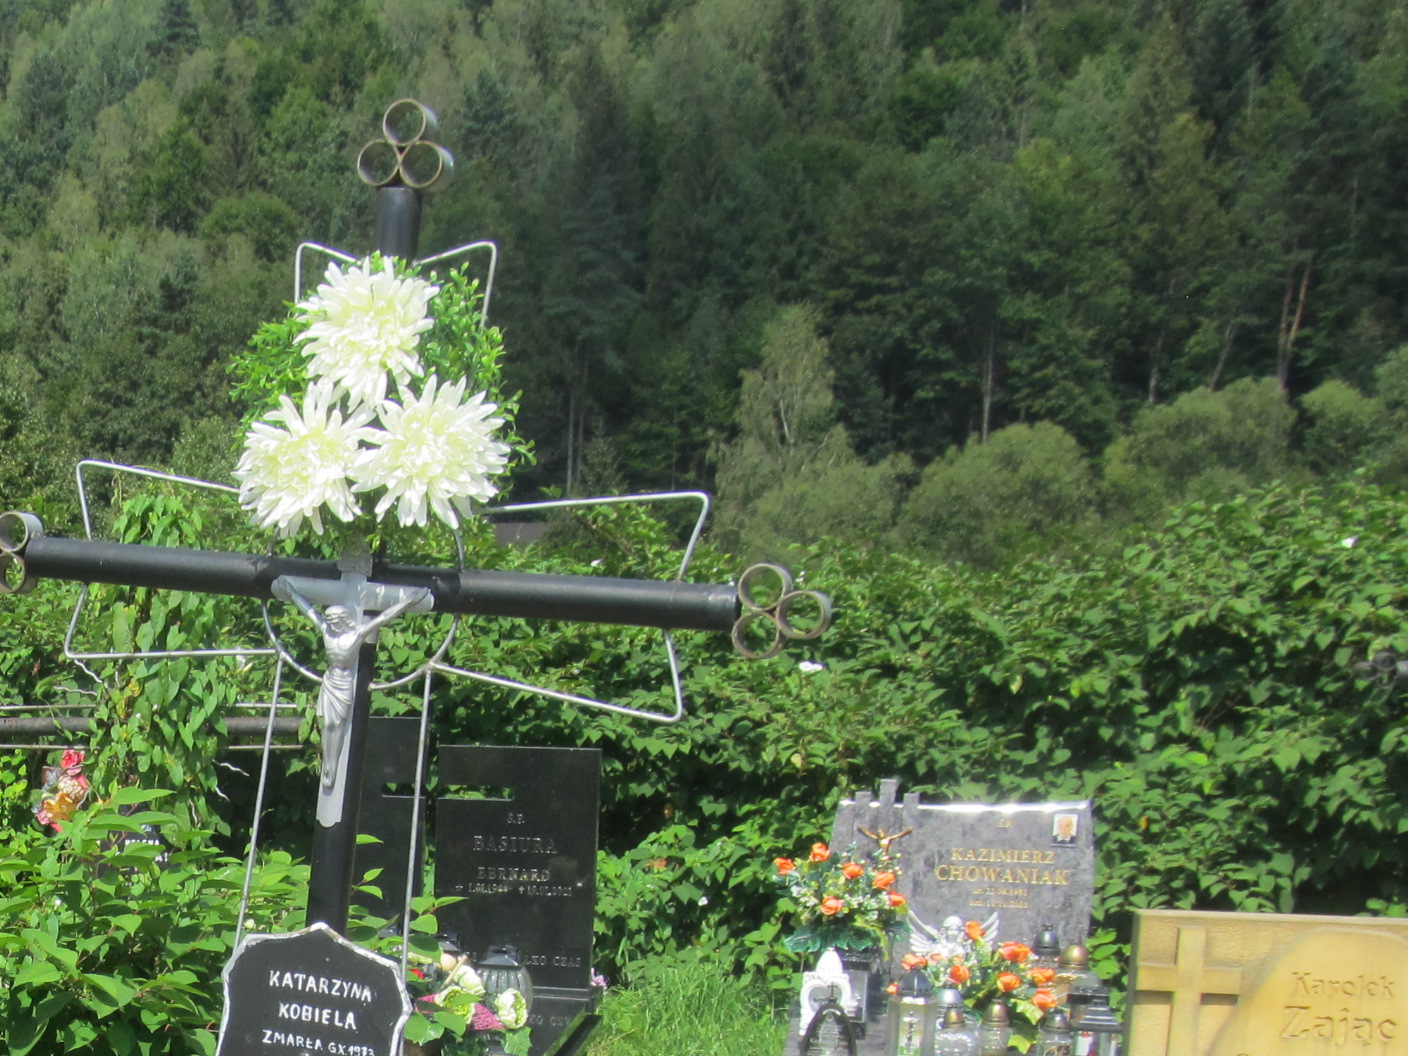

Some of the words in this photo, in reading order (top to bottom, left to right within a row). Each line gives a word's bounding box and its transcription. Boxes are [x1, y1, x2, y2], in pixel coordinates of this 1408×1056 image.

[472, 835, 558, 854] BASIURA
[950, 847, 1057, 864] KAZIMIERZ
[935, 864, 1070, 885] CHOWANIAK
[268, 969, 373, 1003] KATARZYNA
[1291, 971, 1396, 999] Karolek
[278, 1001, 357, 1030] KOBIELA
[1279, 1004, 1398, 1046] Zając
[262, 1029, 324, 1051] ZMARŁA
